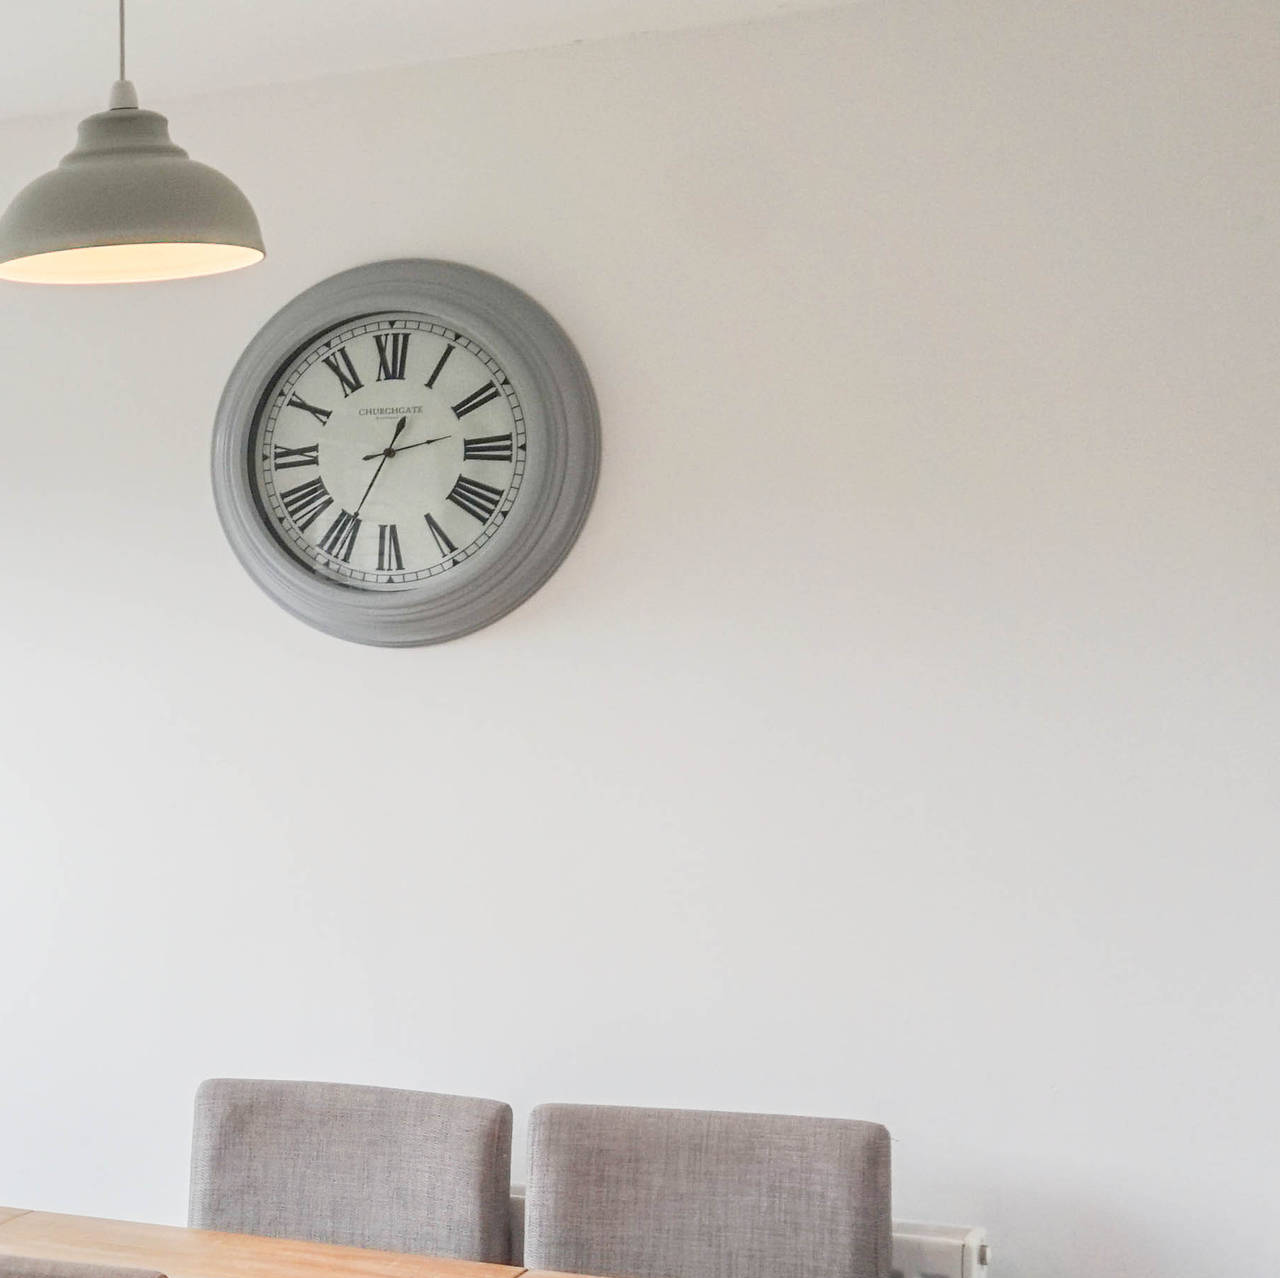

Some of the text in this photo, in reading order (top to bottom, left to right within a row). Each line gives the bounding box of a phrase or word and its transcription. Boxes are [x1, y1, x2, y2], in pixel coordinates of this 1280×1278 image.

[322, 346, 364, 398] XI
[373, 332, 412, 382] XII
[424, 343, 456, 390] I
[286, 391, 333, 427] X
[358, 406, 423, 416] CHURCHGATE
[451, 379, 502, 420] II
[274, 443, 319, 471] IX
[463, 432, 513, 463] III
[279, 475, 334, 533] VIII
[445, 473, 505, 526] IIII
[316, 508, 362, 563] VII
[376, 524, 405, 571] VI
[424, 512, 458, 557] V
